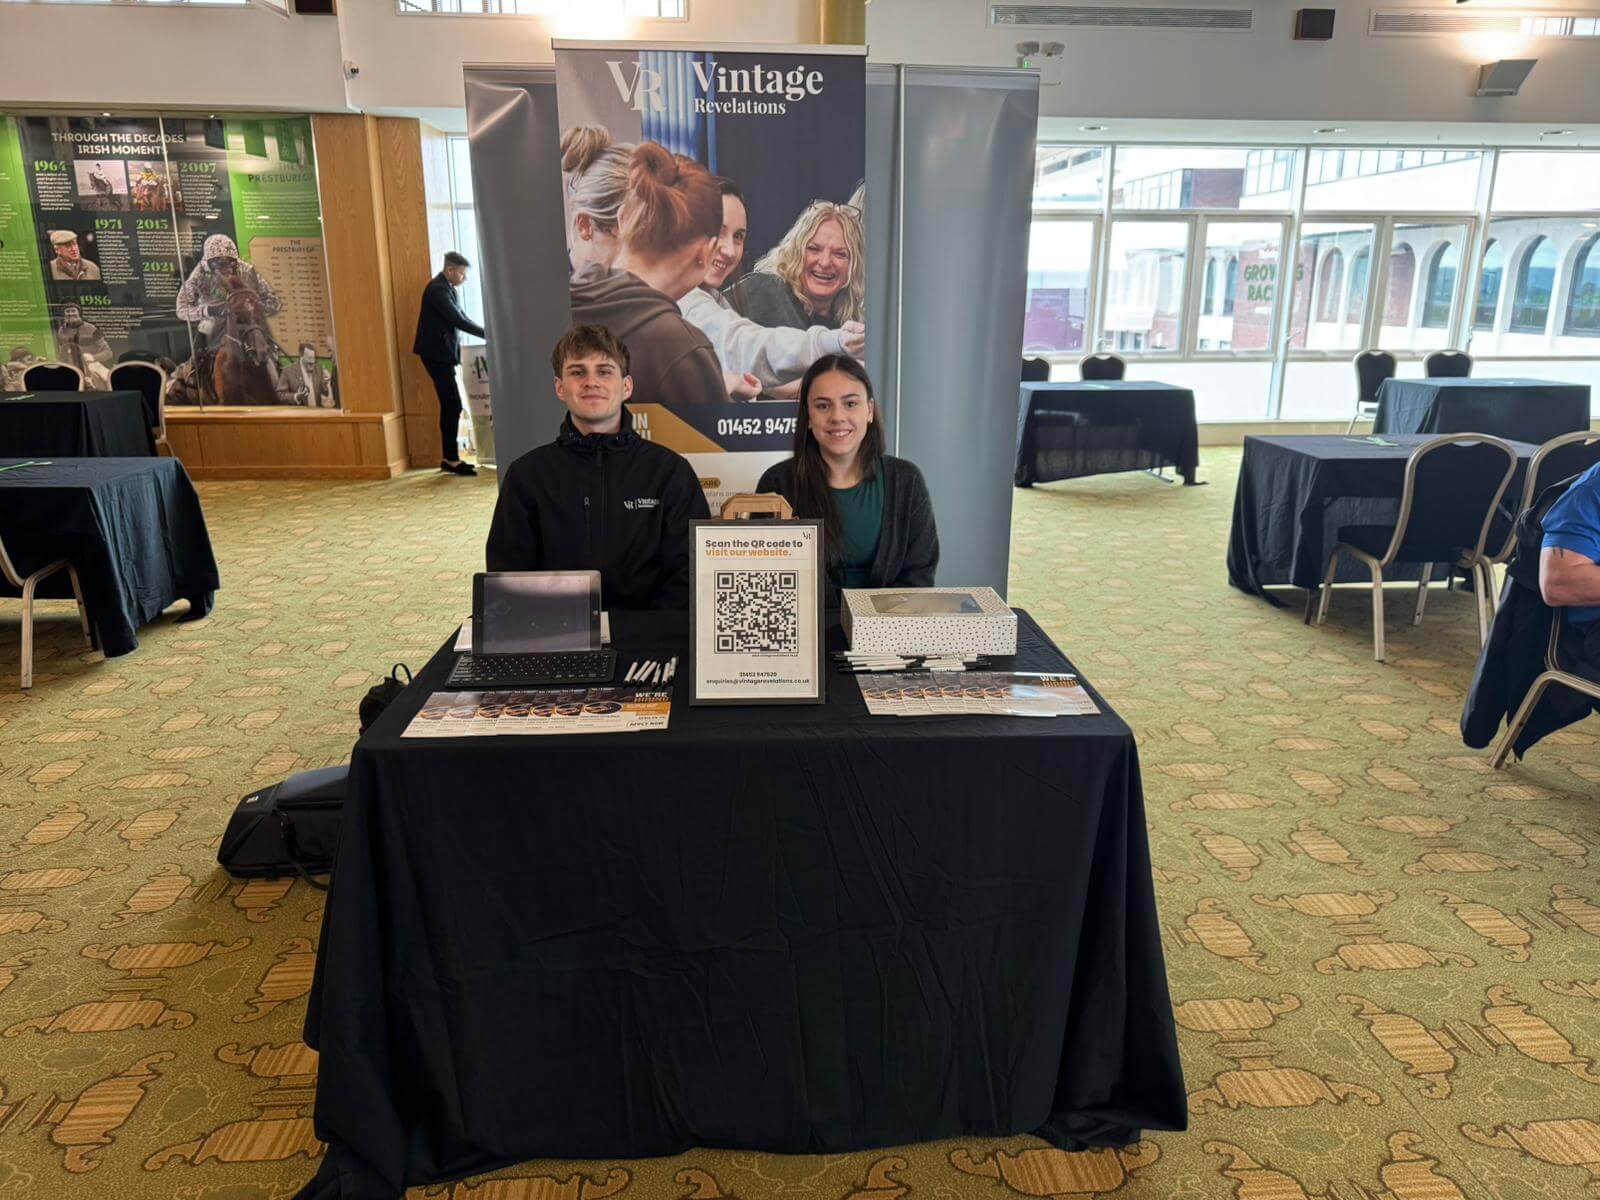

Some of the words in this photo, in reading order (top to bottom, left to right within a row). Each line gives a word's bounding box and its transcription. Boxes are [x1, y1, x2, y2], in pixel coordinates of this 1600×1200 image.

[692, 61, 824, 101] Vintage
[694, 98, 786, 115] Revelations
[51, 133, 108, 142] THROUGH
[109, 133, 131, 143] THE
[134, 134, 184, 143] DECADES
[78, 145, 110, 154] IRISH
[34, 160, 67, 172] 1964
[180, 162, 217, 173] 2007
[95, 219, 122, 230] 1971
[136, 219, 168, 230] 2015
[142, 262, 174, 272] 2021
[1247, 284, 1274, 301] RAC
[79, 295, 111, 306] 1986
[717, 418, 762, 436] 01452
[705, 540, 731, 548] Scan
[732, 540, 749, 548] the
[751, 540, 765, 549] QR
[766, 540, 791, 548] code
[793, 540, 803, 548] to
[705, 548, 728, 556] visit
[748, 548, 792, 556] website.
